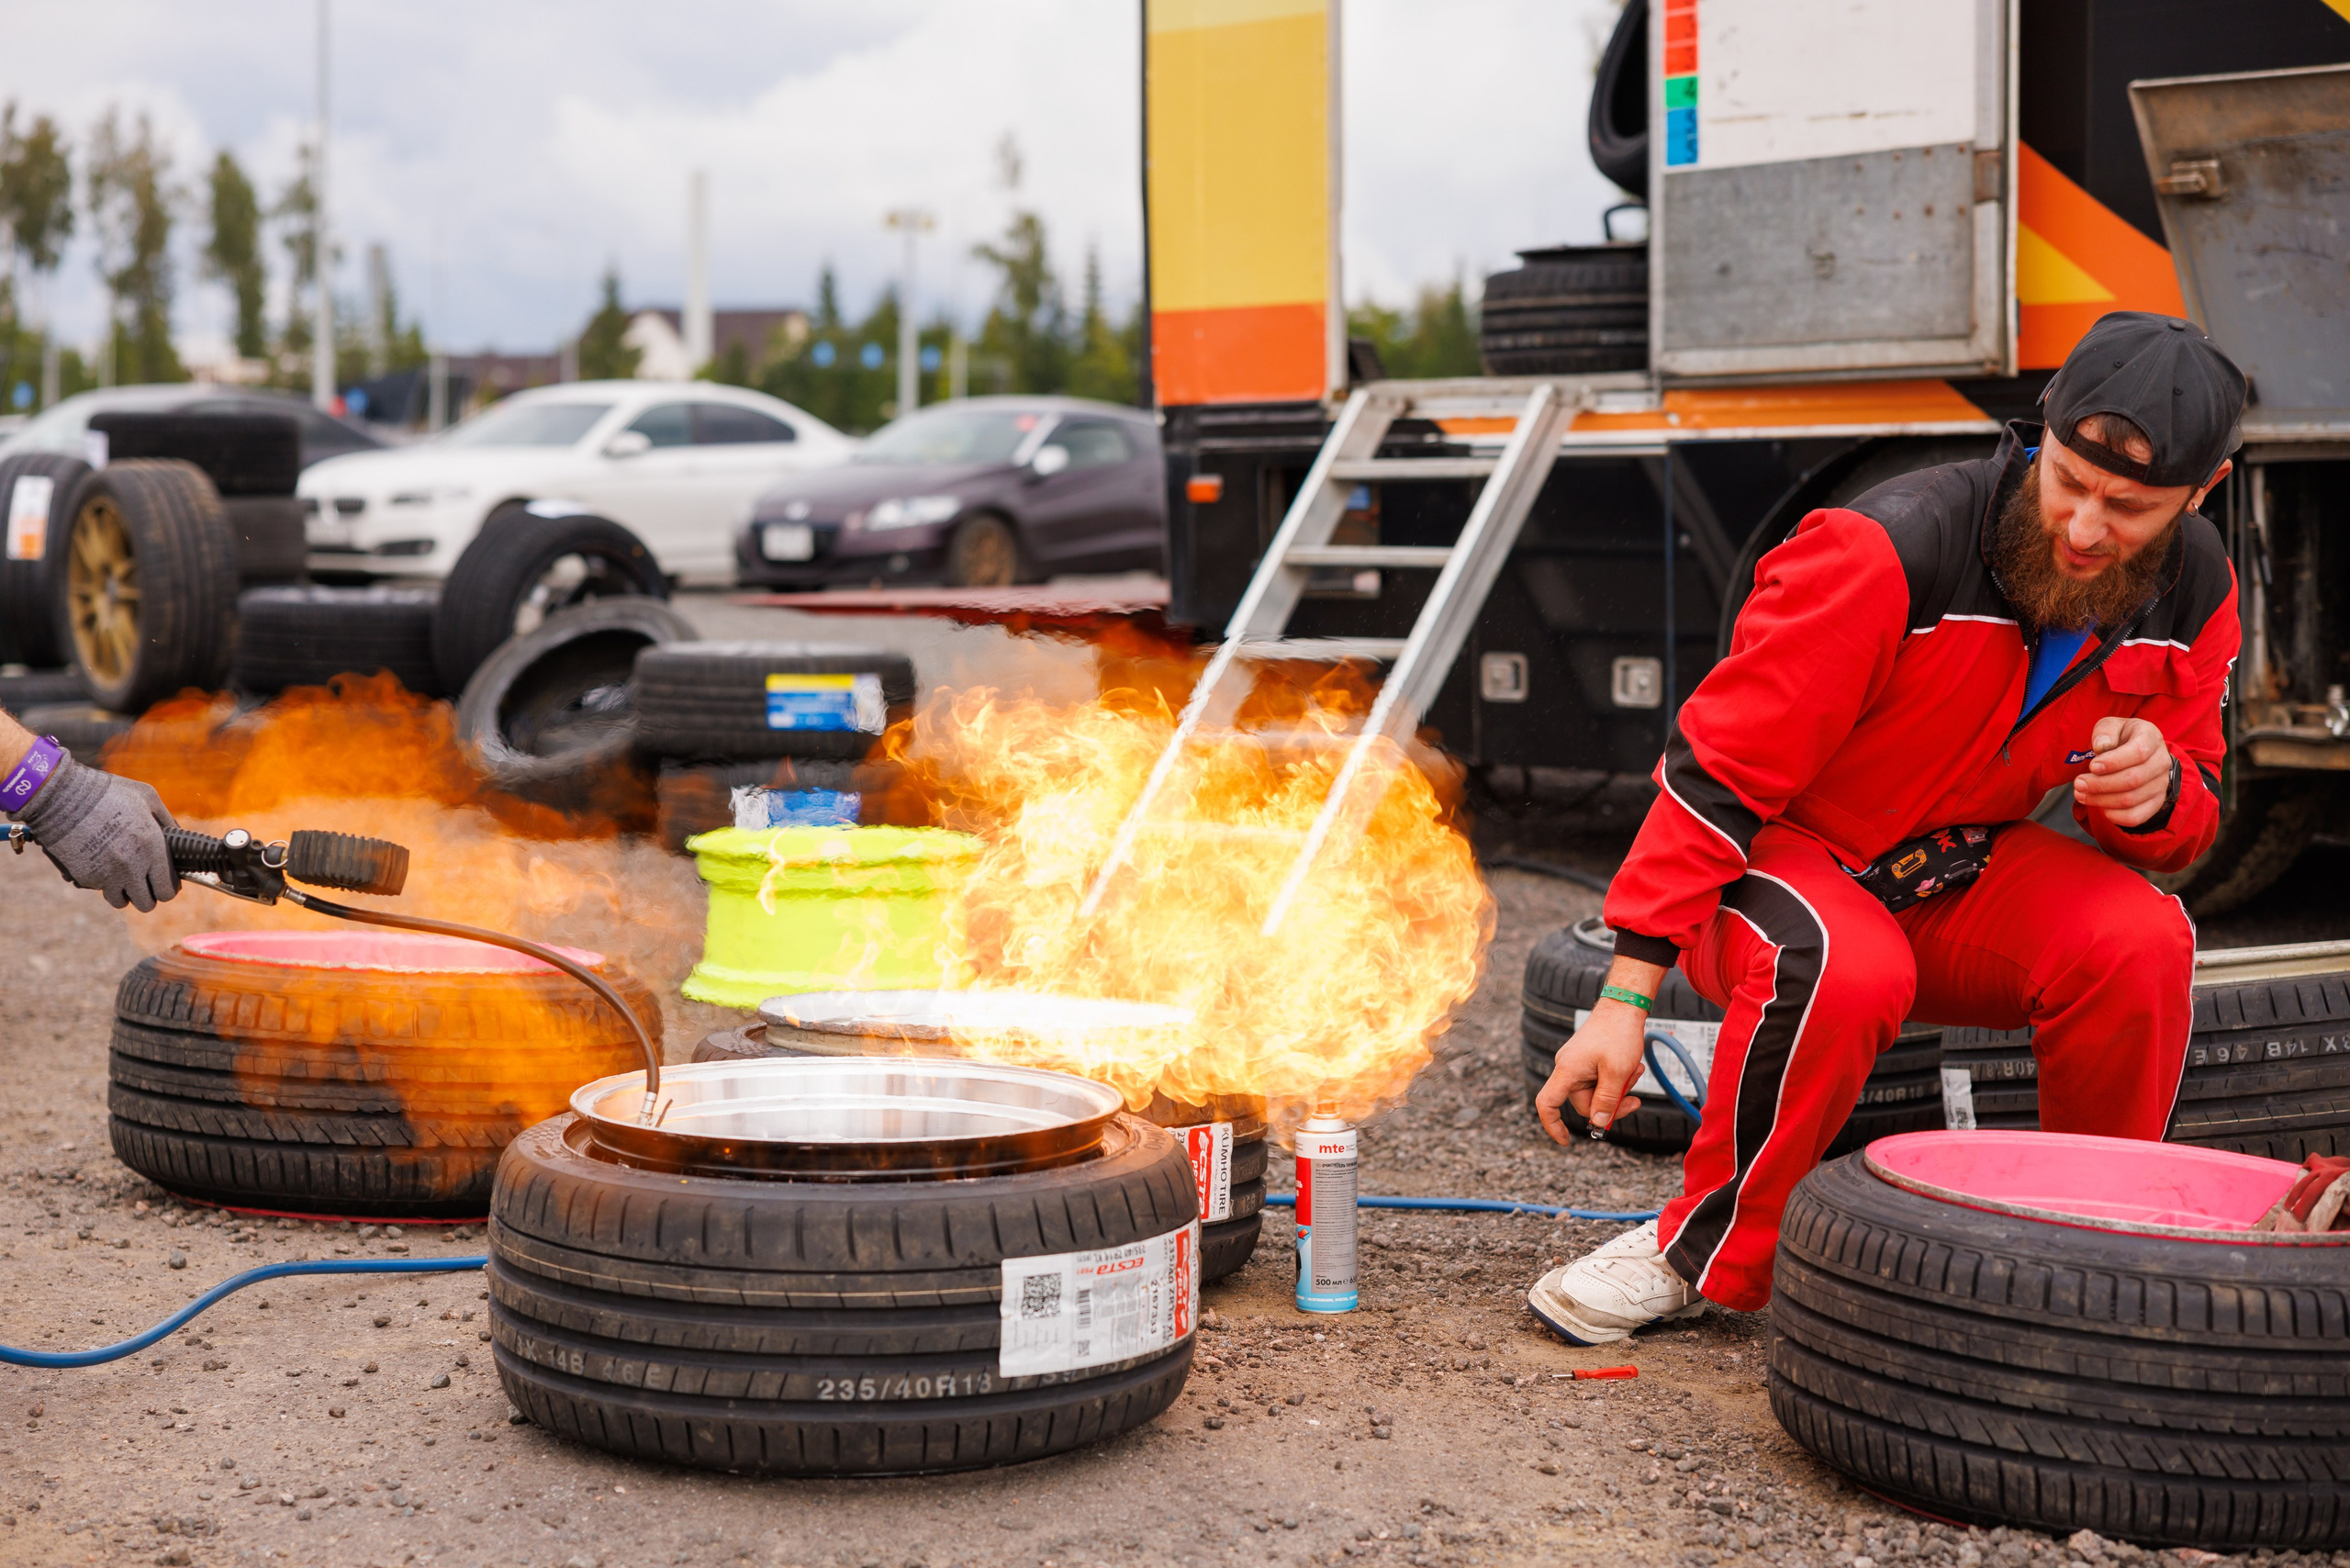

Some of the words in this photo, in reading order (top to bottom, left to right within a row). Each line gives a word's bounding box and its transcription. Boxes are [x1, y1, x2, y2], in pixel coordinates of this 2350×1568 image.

[1319, 1144, 1345, 1154] mte
[1218, 1183, 1227, 1215] TIRE
[1315, 1278, 1331, 1286] 500
